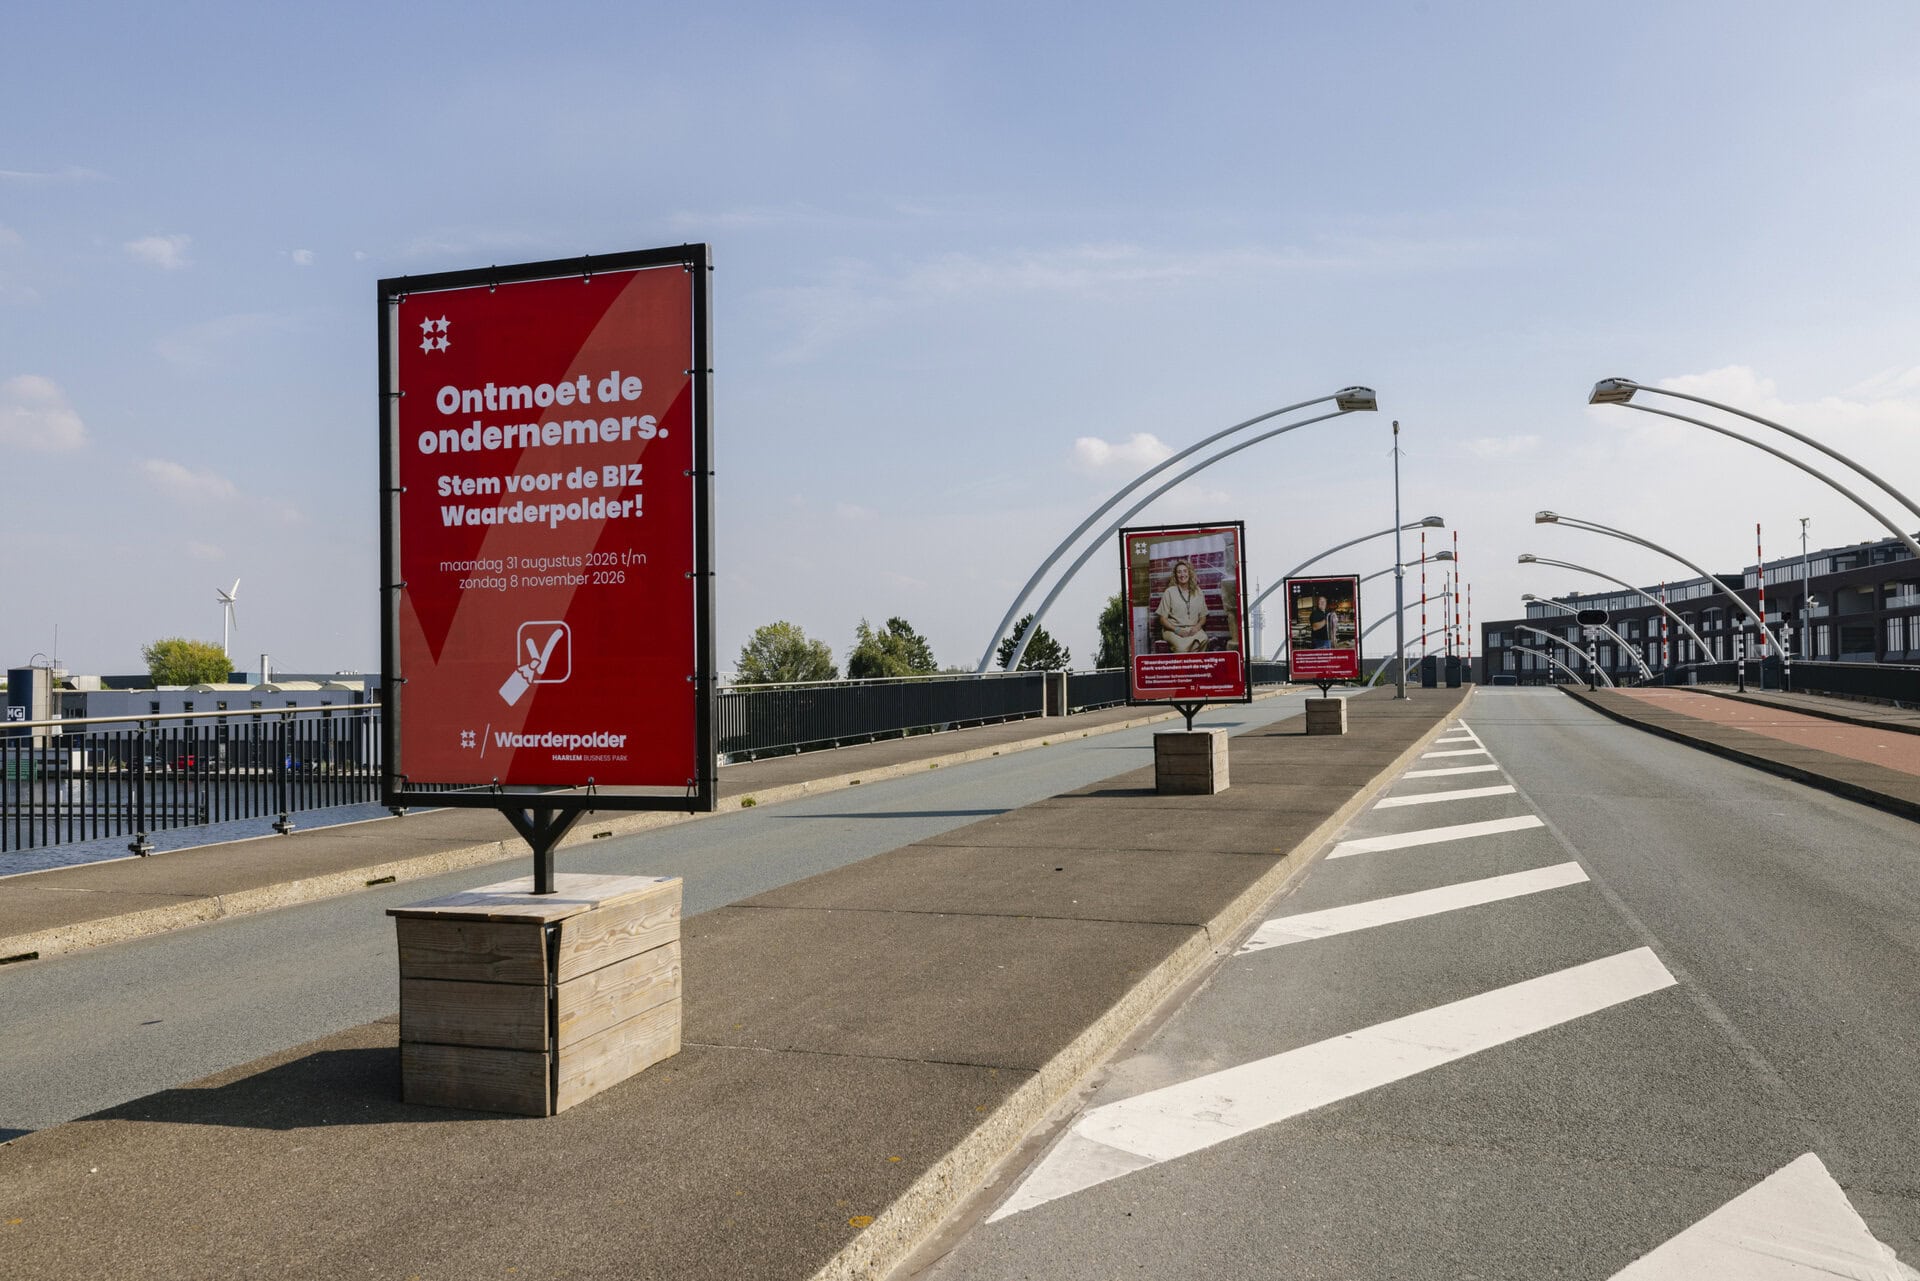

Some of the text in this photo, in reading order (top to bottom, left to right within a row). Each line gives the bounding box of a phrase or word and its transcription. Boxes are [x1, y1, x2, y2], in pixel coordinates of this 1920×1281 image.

[436, 370, 643, 415] Ontmoet de
[418, 414, 669, 454] ondernemers.
[437, 463, 643, 497] Stem voor de BIZ
[440, 494, 643, 529] Waarderpolder!
[440, 548, 647, 573] maandag 31 augustus 2026 t/m
[459, 571, 625, 591] zondag 8 november 2026
[494, 730, 627, 751] Waarderpolder
